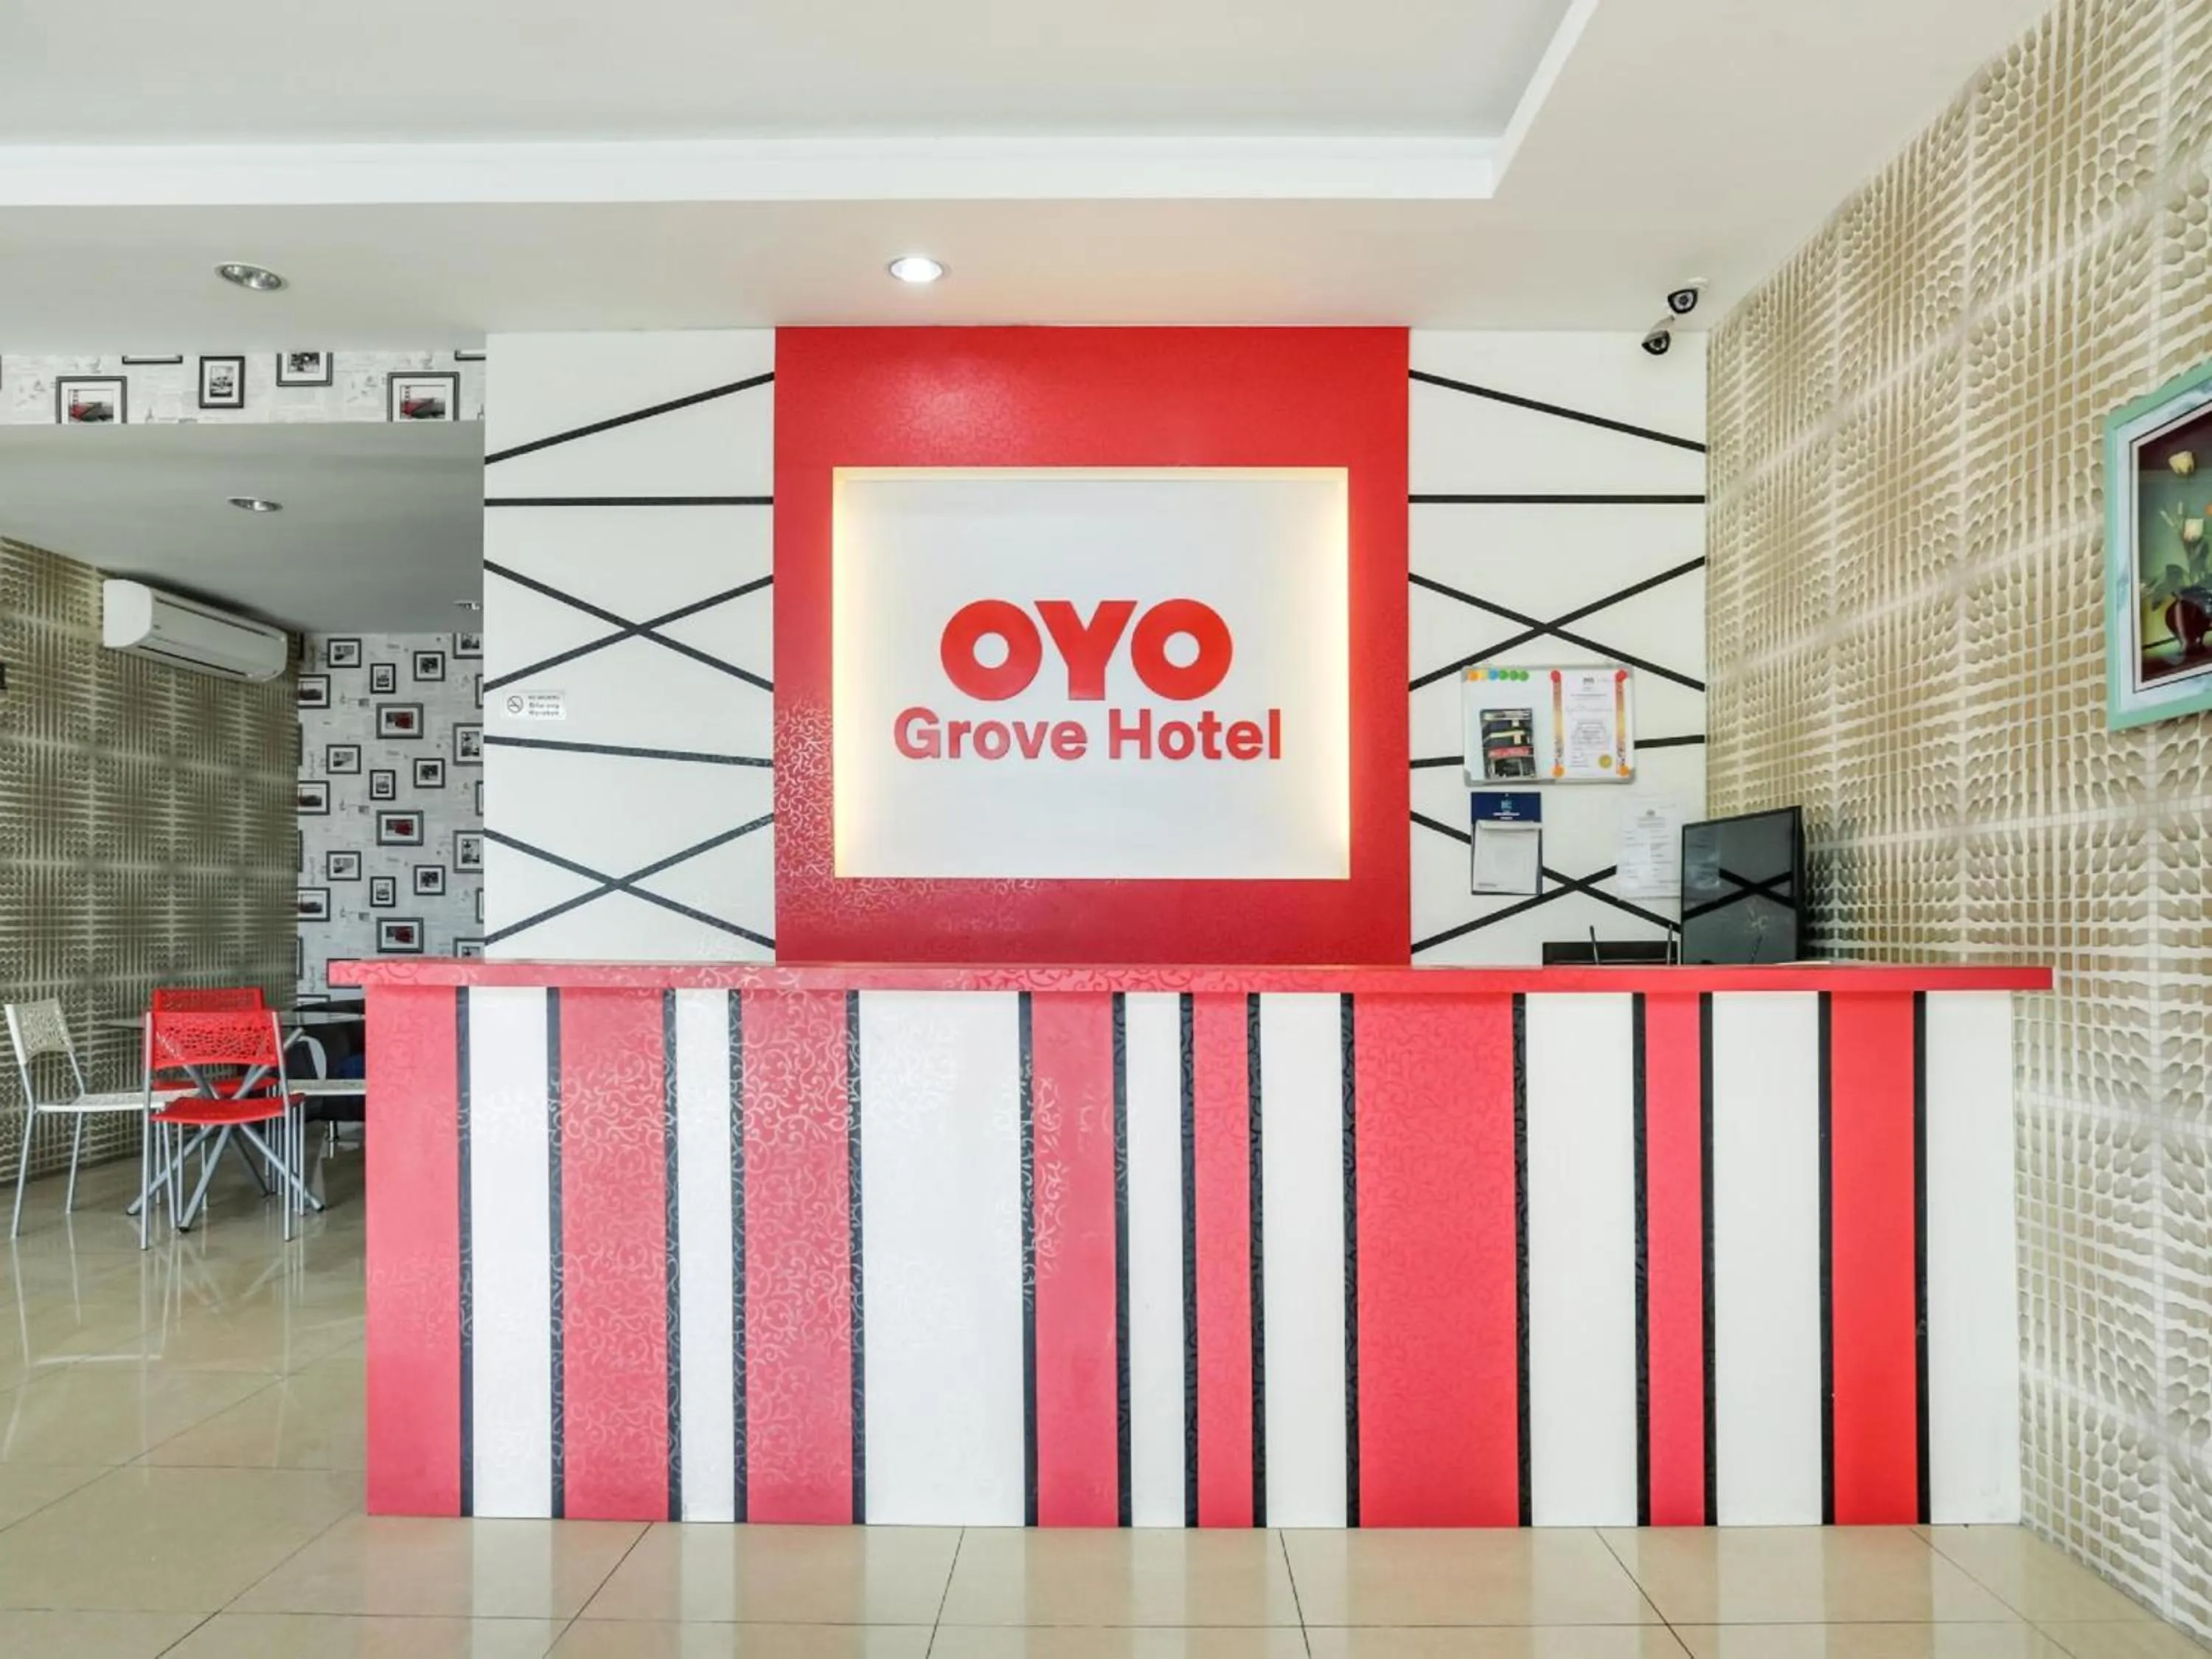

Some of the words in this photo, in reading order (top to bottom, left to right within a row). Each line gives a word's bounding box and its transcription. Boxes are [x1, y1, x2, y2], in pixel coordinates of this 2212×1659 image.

[940, 599, 1233, 700] OYO
[894, 706, 1088, 760] Grove
[1109, 709, 1281, 759] Hotel
